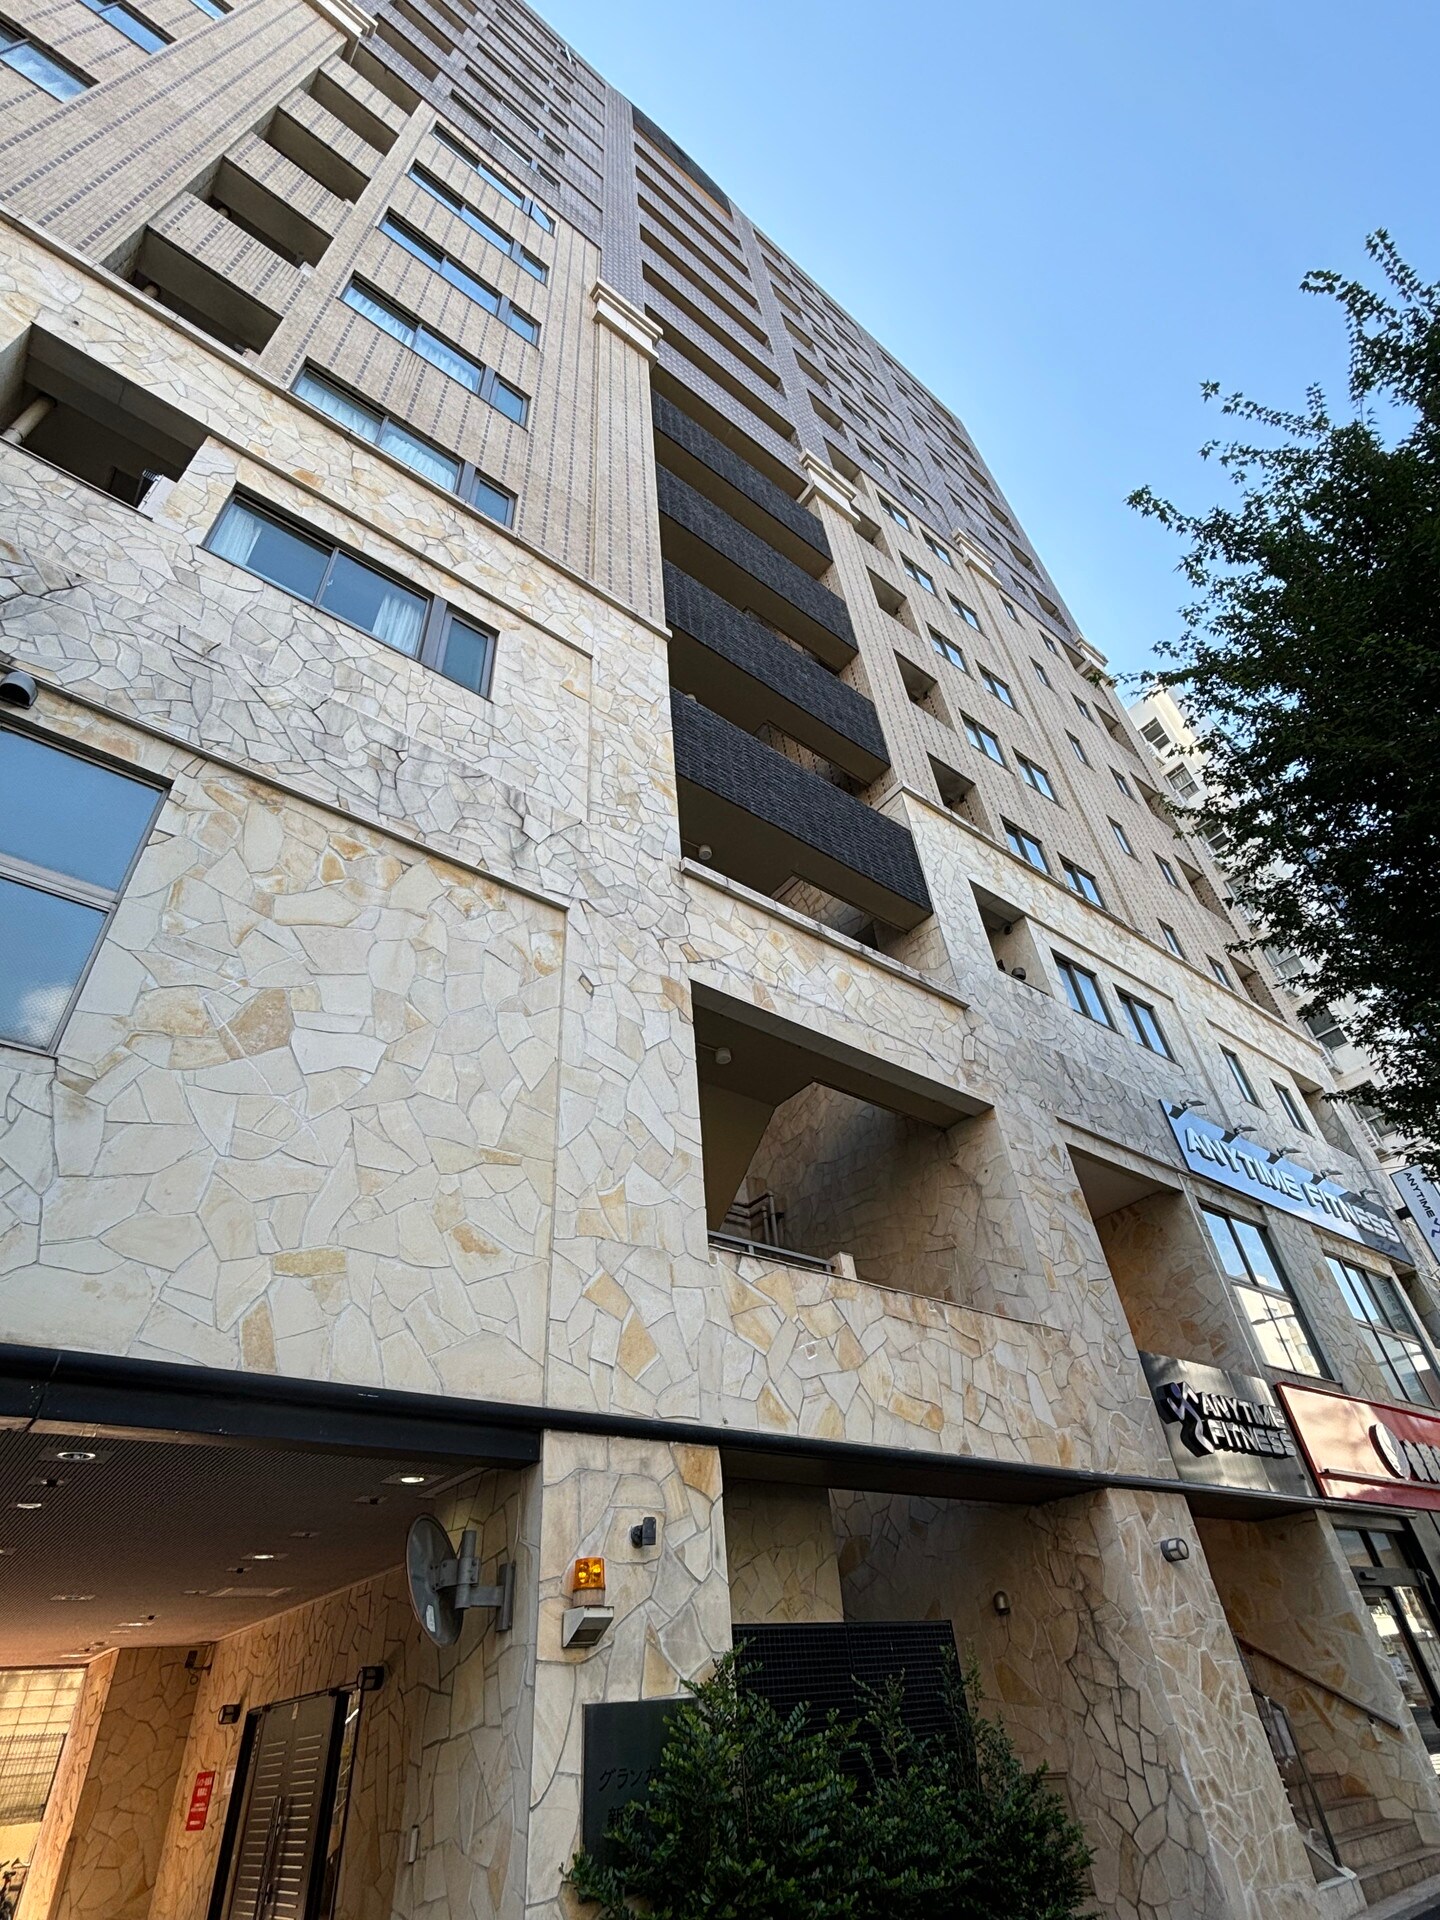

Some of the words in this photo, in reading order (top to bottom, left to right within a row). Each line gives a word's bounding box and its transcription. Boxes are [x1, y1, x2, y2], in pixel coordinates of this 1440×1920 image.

[1185, 1127, 1303, 1201] ANYTIME
[1300, 1182, 1400, 1244] FITNESS
[1404, 1172, 1435, 1218] ANYTIME
[1201, 1392, 1287, 1430] ANYTIME
[1208, 1419, 1297, 1457] FITNESS
